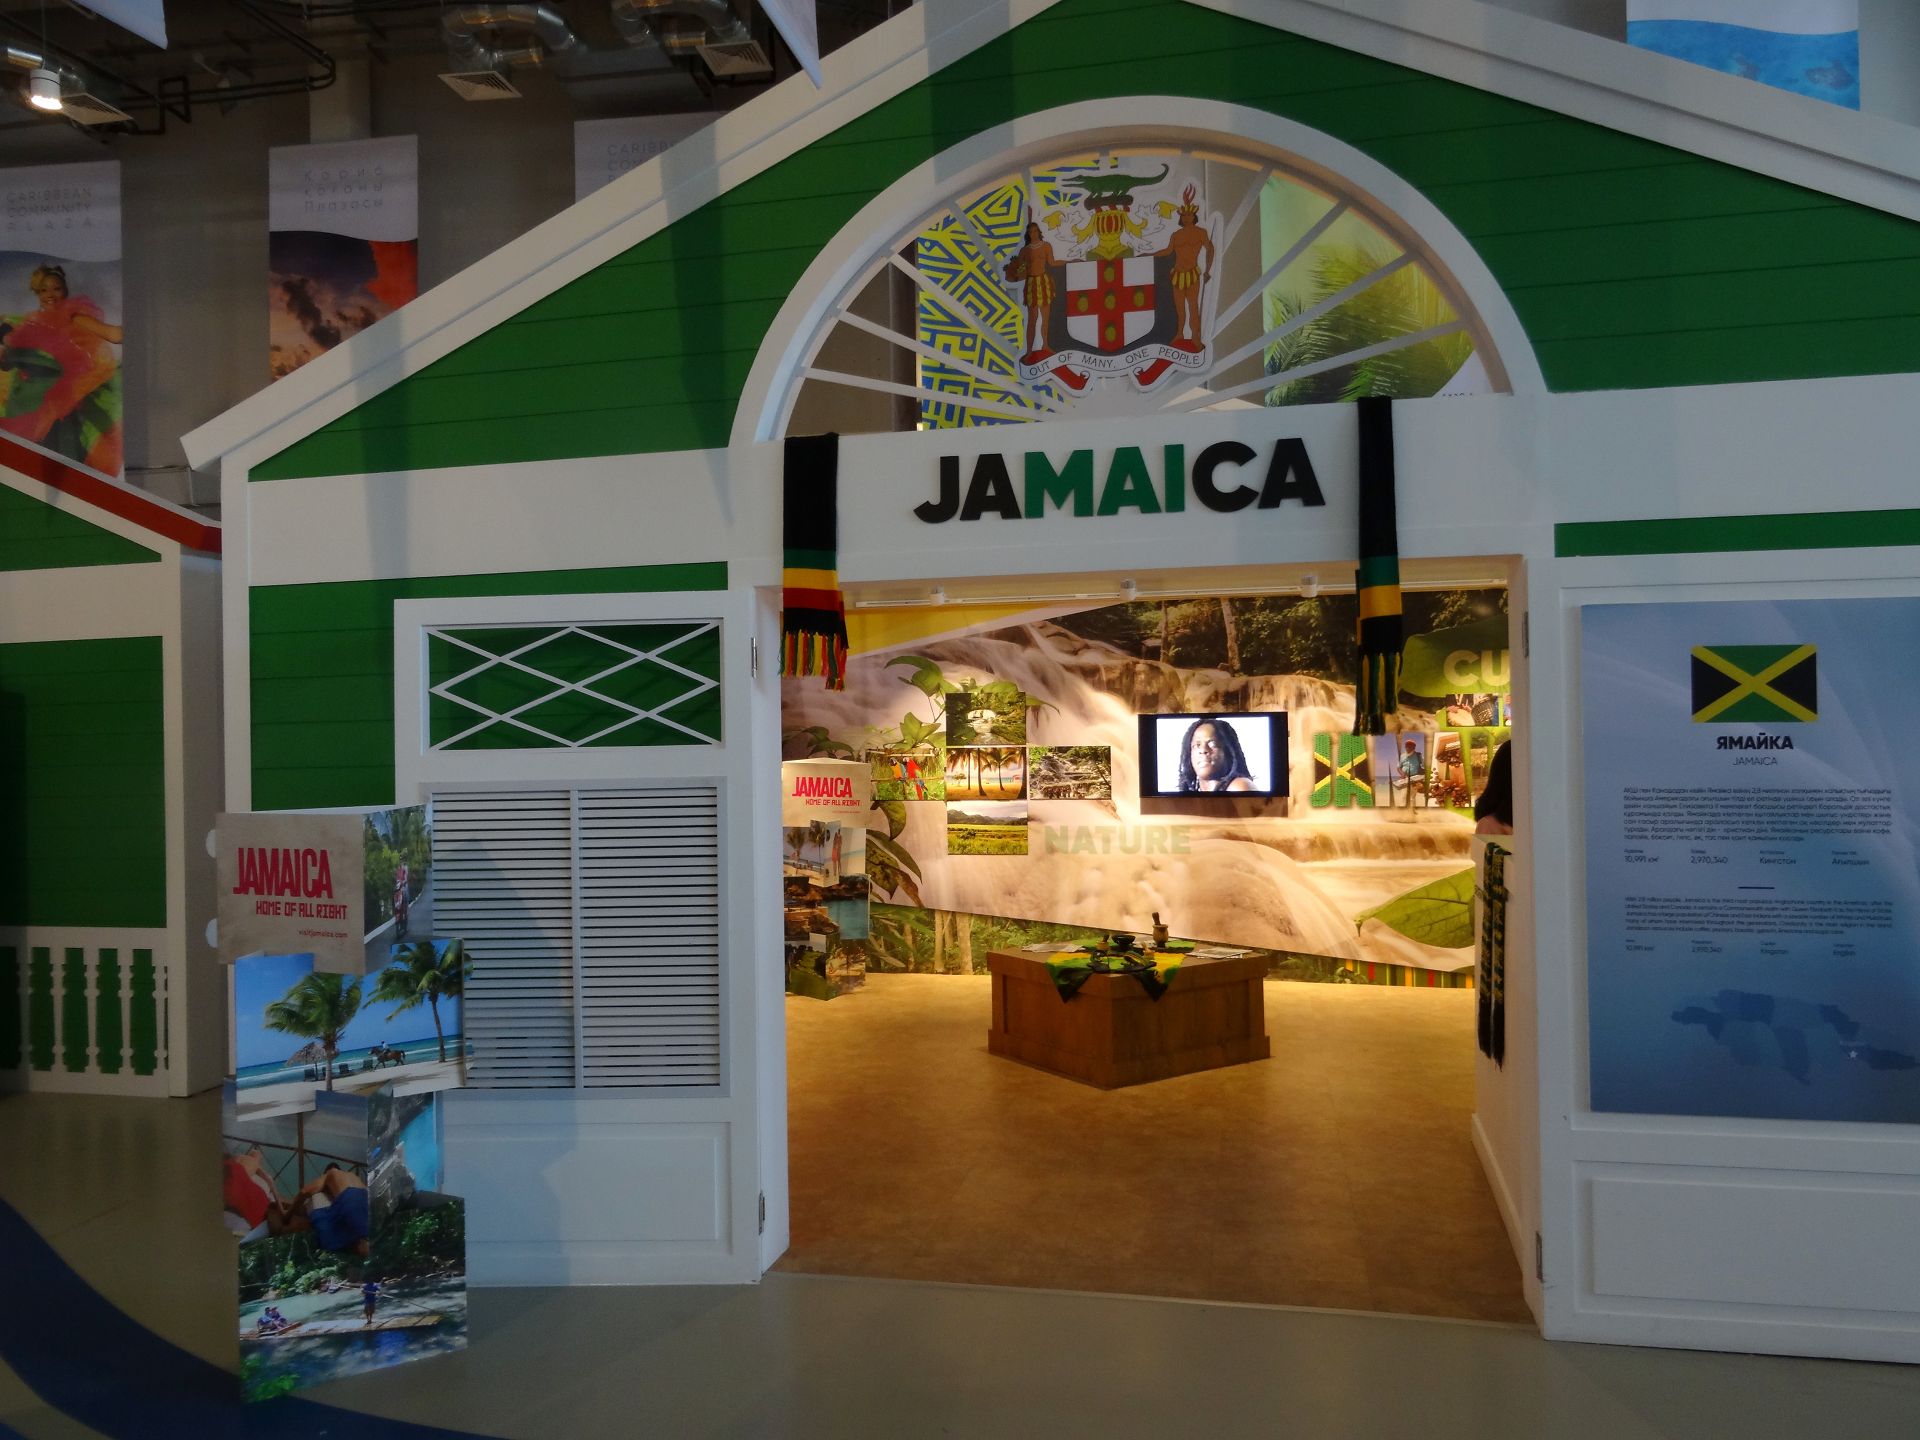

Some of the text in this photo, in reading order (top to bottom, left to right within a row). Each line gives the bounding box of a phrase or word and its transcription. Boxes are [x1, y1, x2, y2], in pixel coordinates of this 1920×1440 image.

[1029, 362, 1050, 376] OUT
[1058, 352, 1073, 363] OF
[1125, 348, 1150, 364] ONE
[1158, 346, 1200, 365] PEOPLE
[912, 437, 1326, 524] JAMAICA
[1716, 732, 1794, 750] ЯМАЙКА
[1732, 756, 1778, 766] JAMAICA
[792, 777, 852, 798] JAMAICA
[841, 799, 861, 807] RIGHT
[1044, 824, 1191, 854] NATURE
[232, 847, 333, 899] JAMAICA
[256, 900, 347, 920] HOME OF ALL RIGHT
